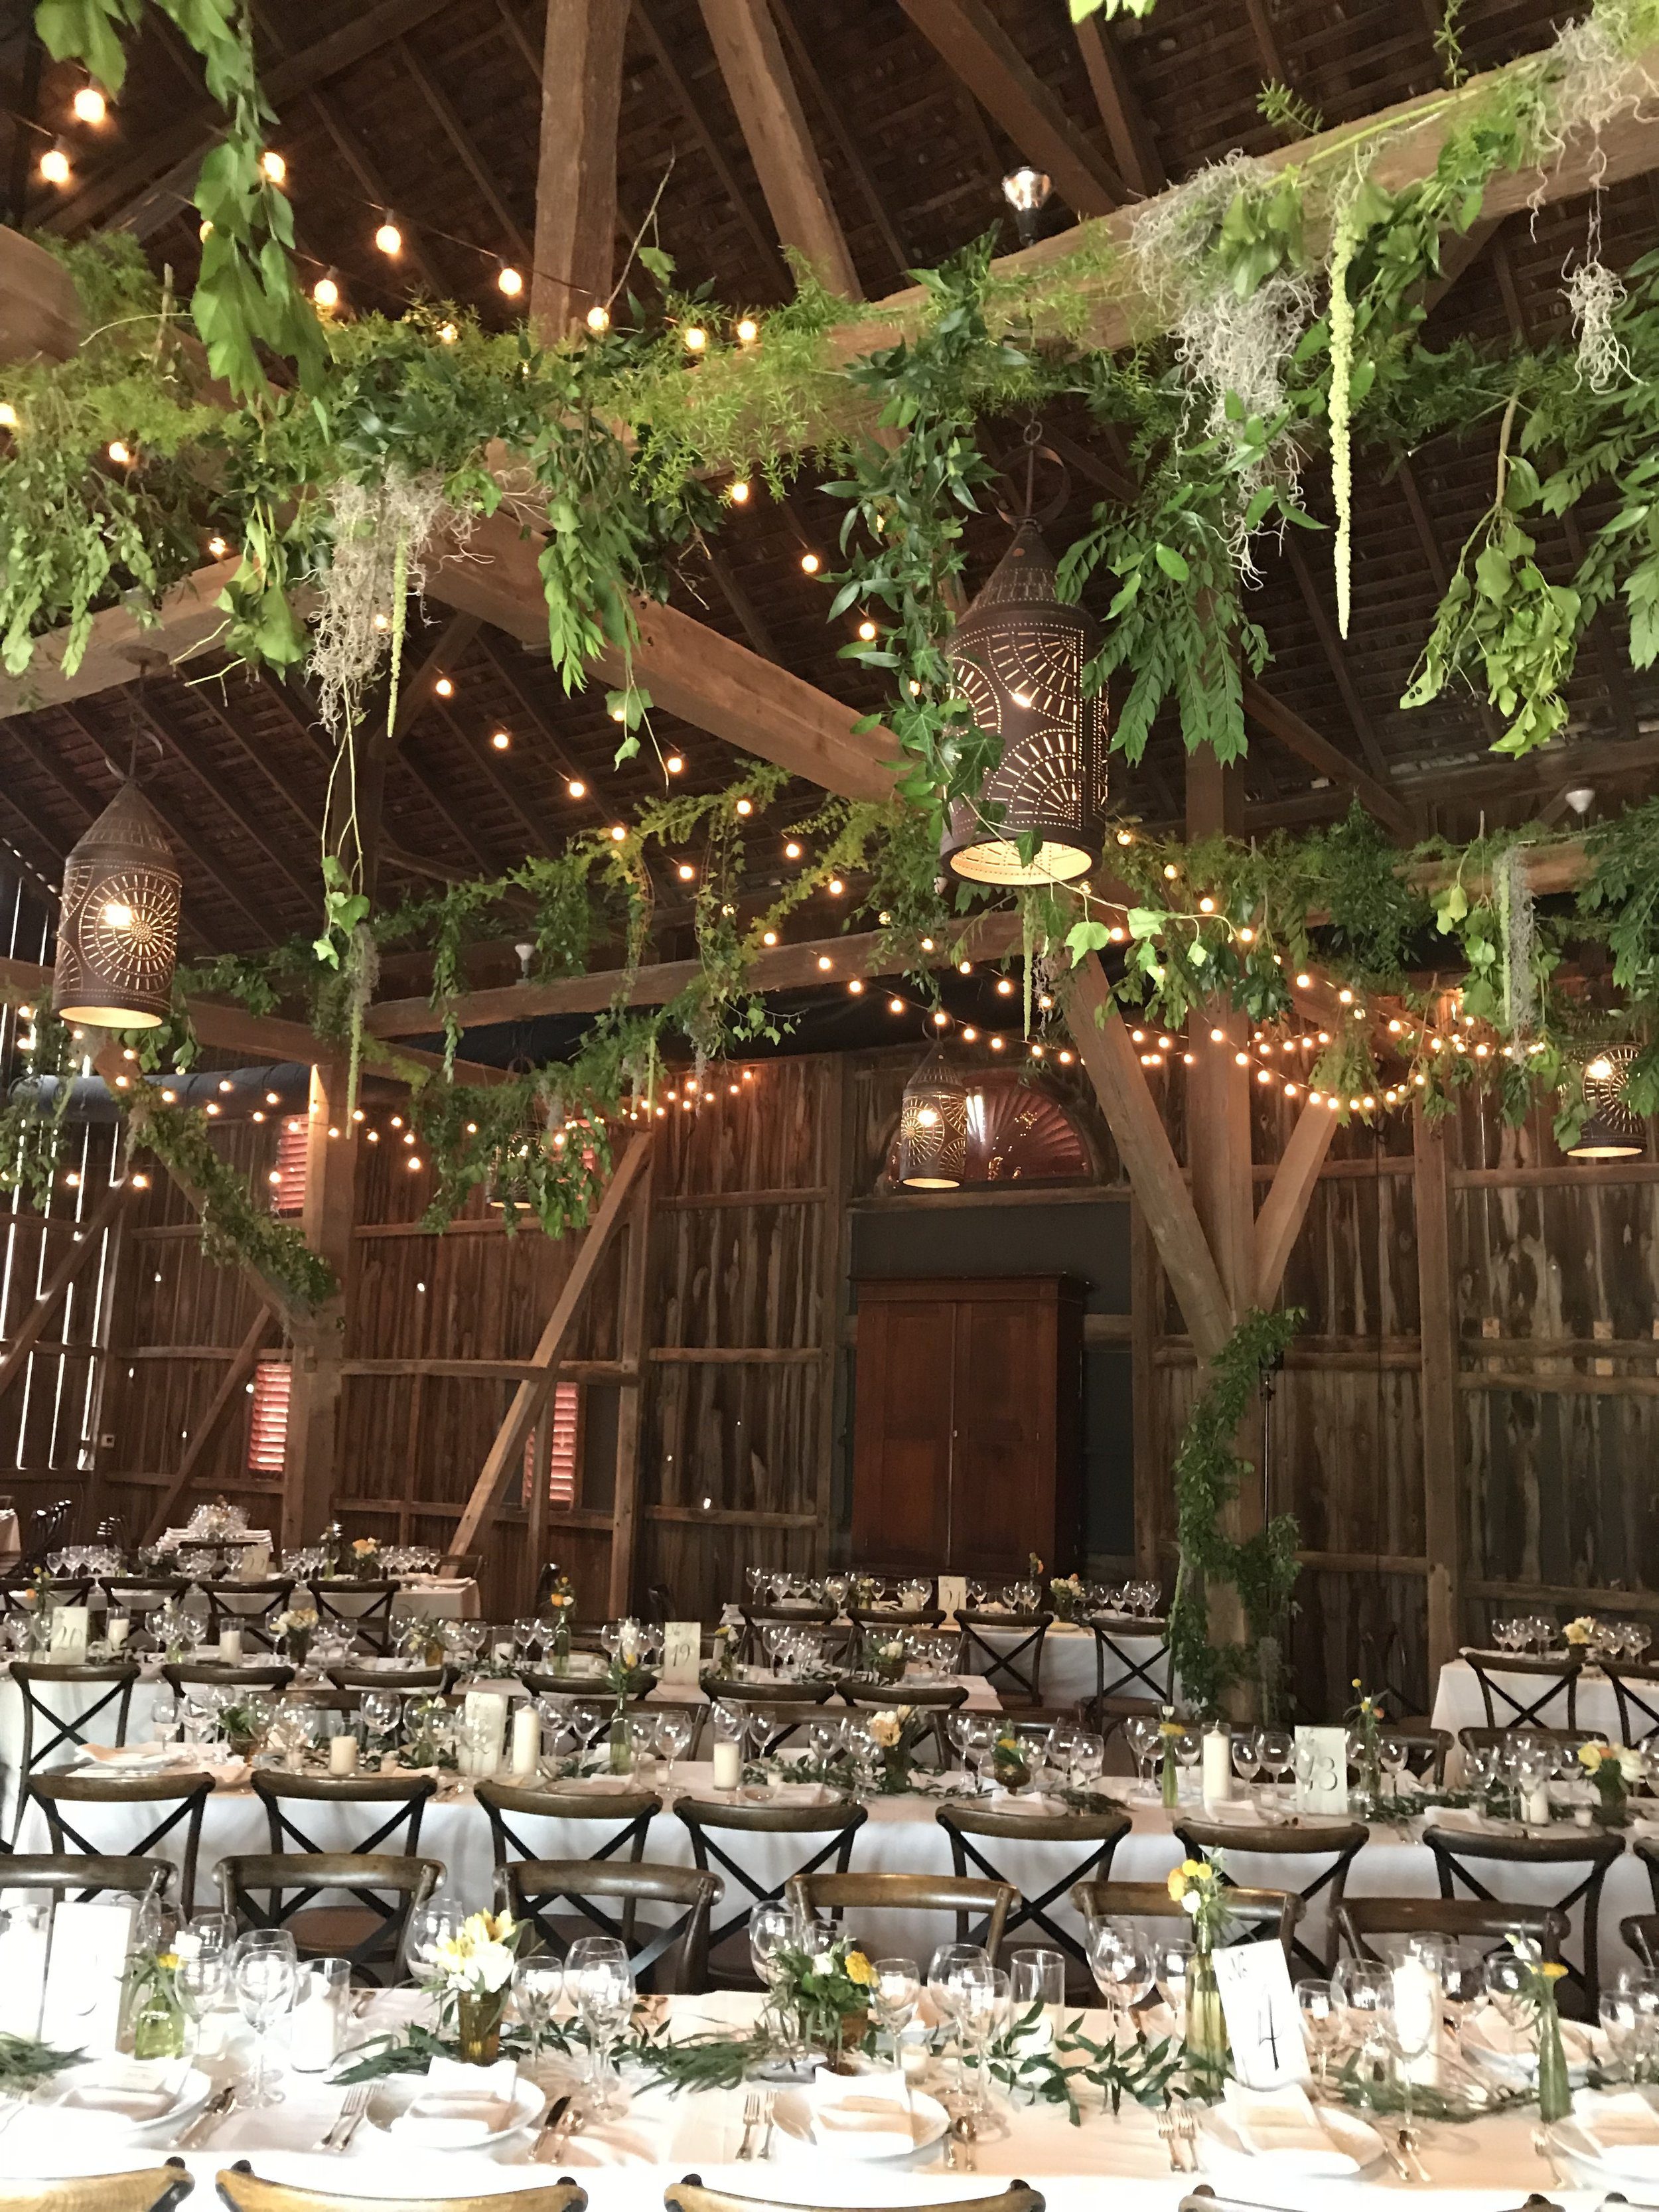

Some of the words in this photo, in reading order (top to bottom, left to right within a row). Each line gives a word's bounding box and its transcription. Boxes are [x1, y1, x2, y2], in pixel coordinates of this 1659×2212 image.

[56, 1626, 83, 1651] 20
[671, 1643, 691, 1667] 19
[1306, 1755, 1338, 1791] 13
[1258, 1993, 1284, 2071] 4
